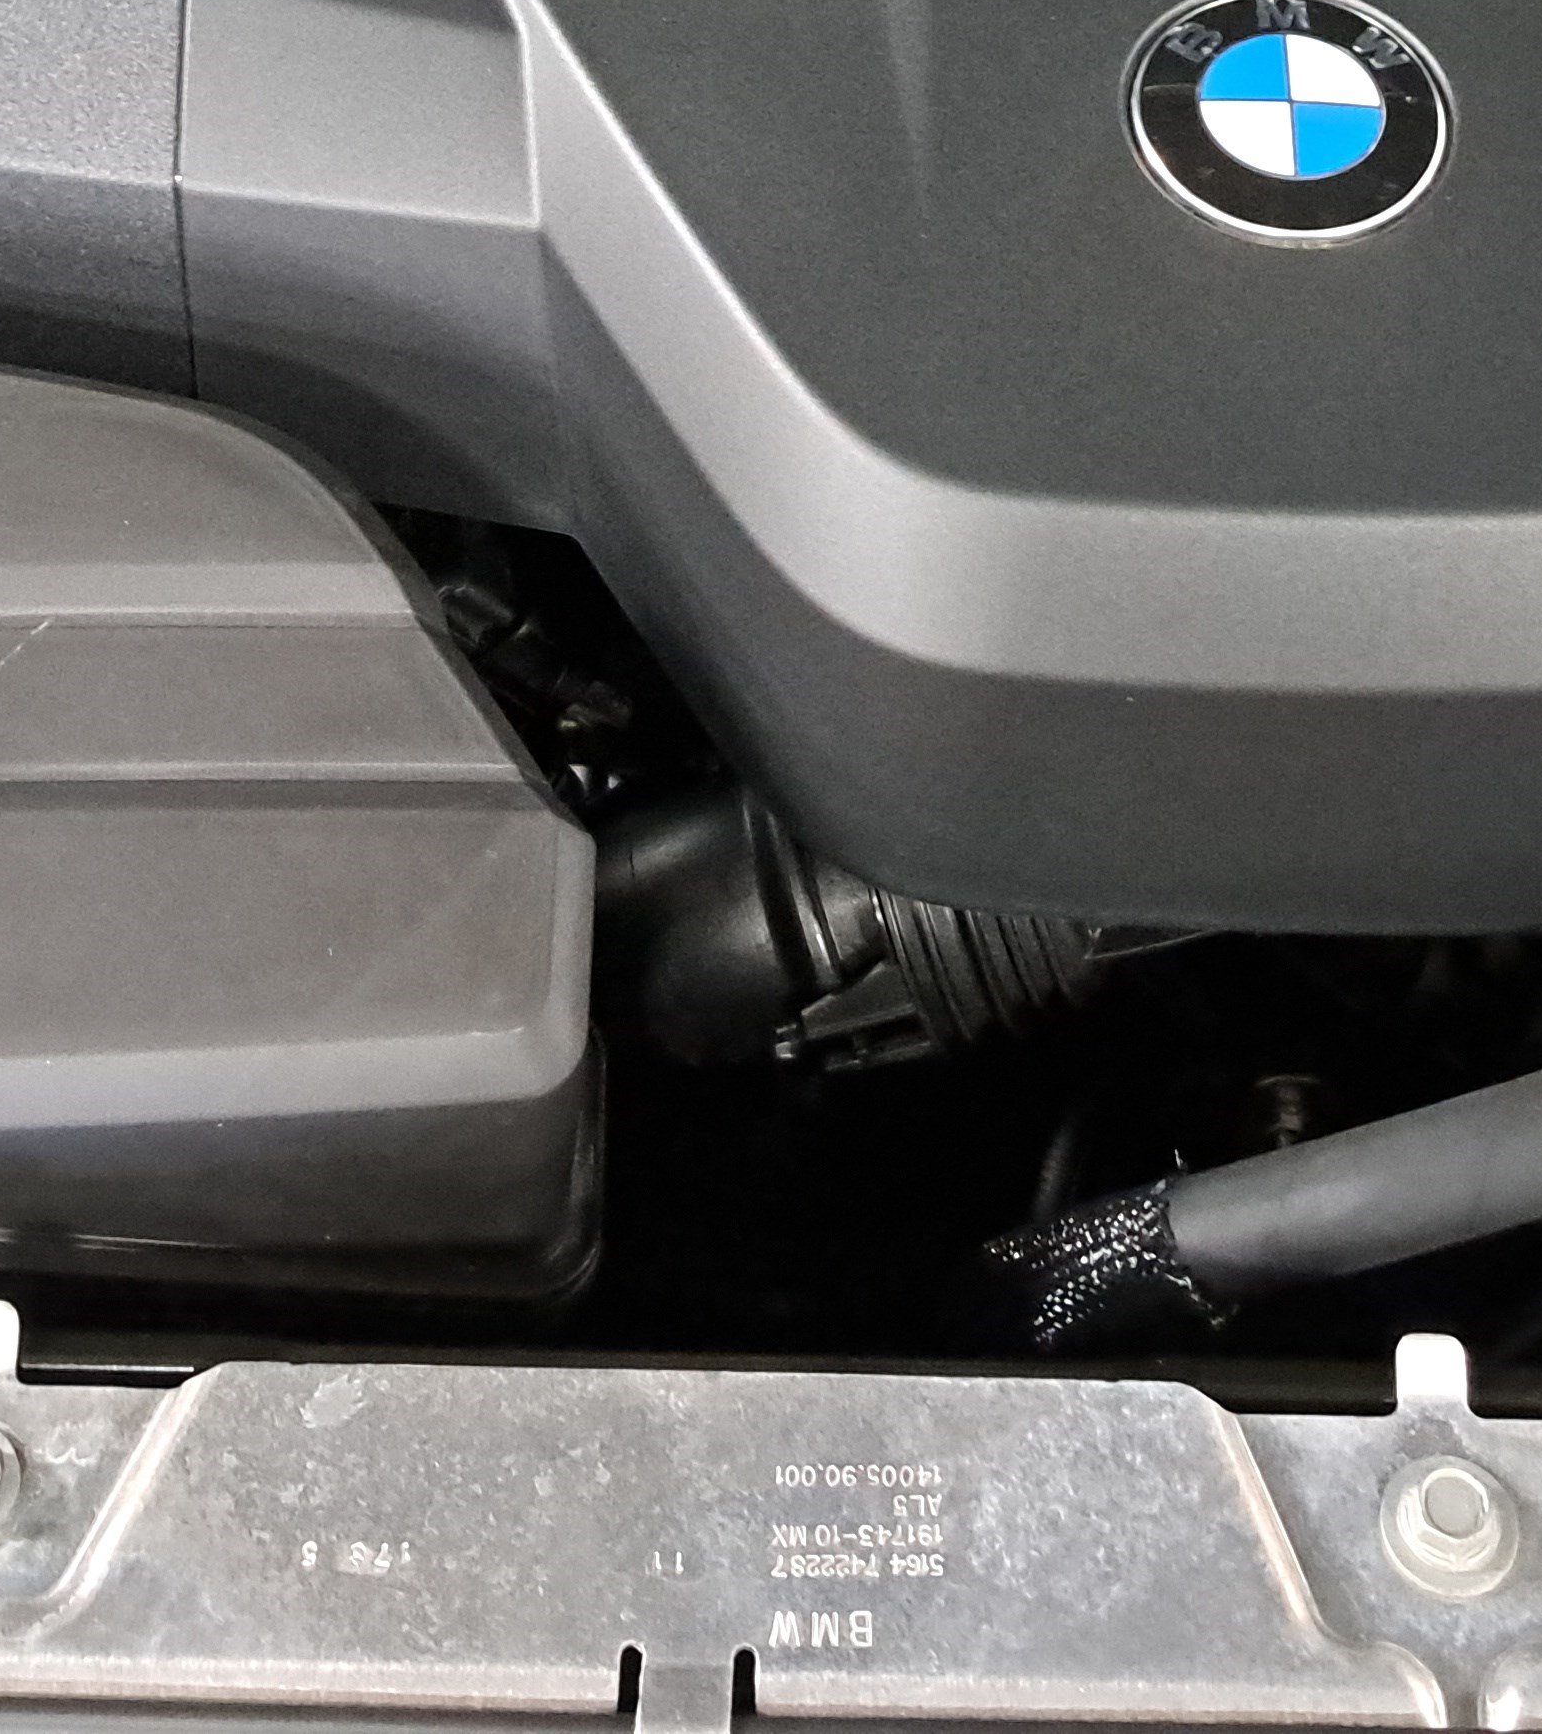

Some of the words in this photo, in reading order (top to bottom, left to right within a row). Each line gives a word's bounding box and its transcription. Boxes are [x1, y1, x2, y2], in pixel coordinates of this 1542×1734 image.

[892, 1493, 943, 1517] AL5
[771, 1523, 807, 1549] MX
[815, 1524, 944, 1548] 191743-10
[889, 1553, 945, 1578] 5164
[768, 1610, 873, 1648] BMW
